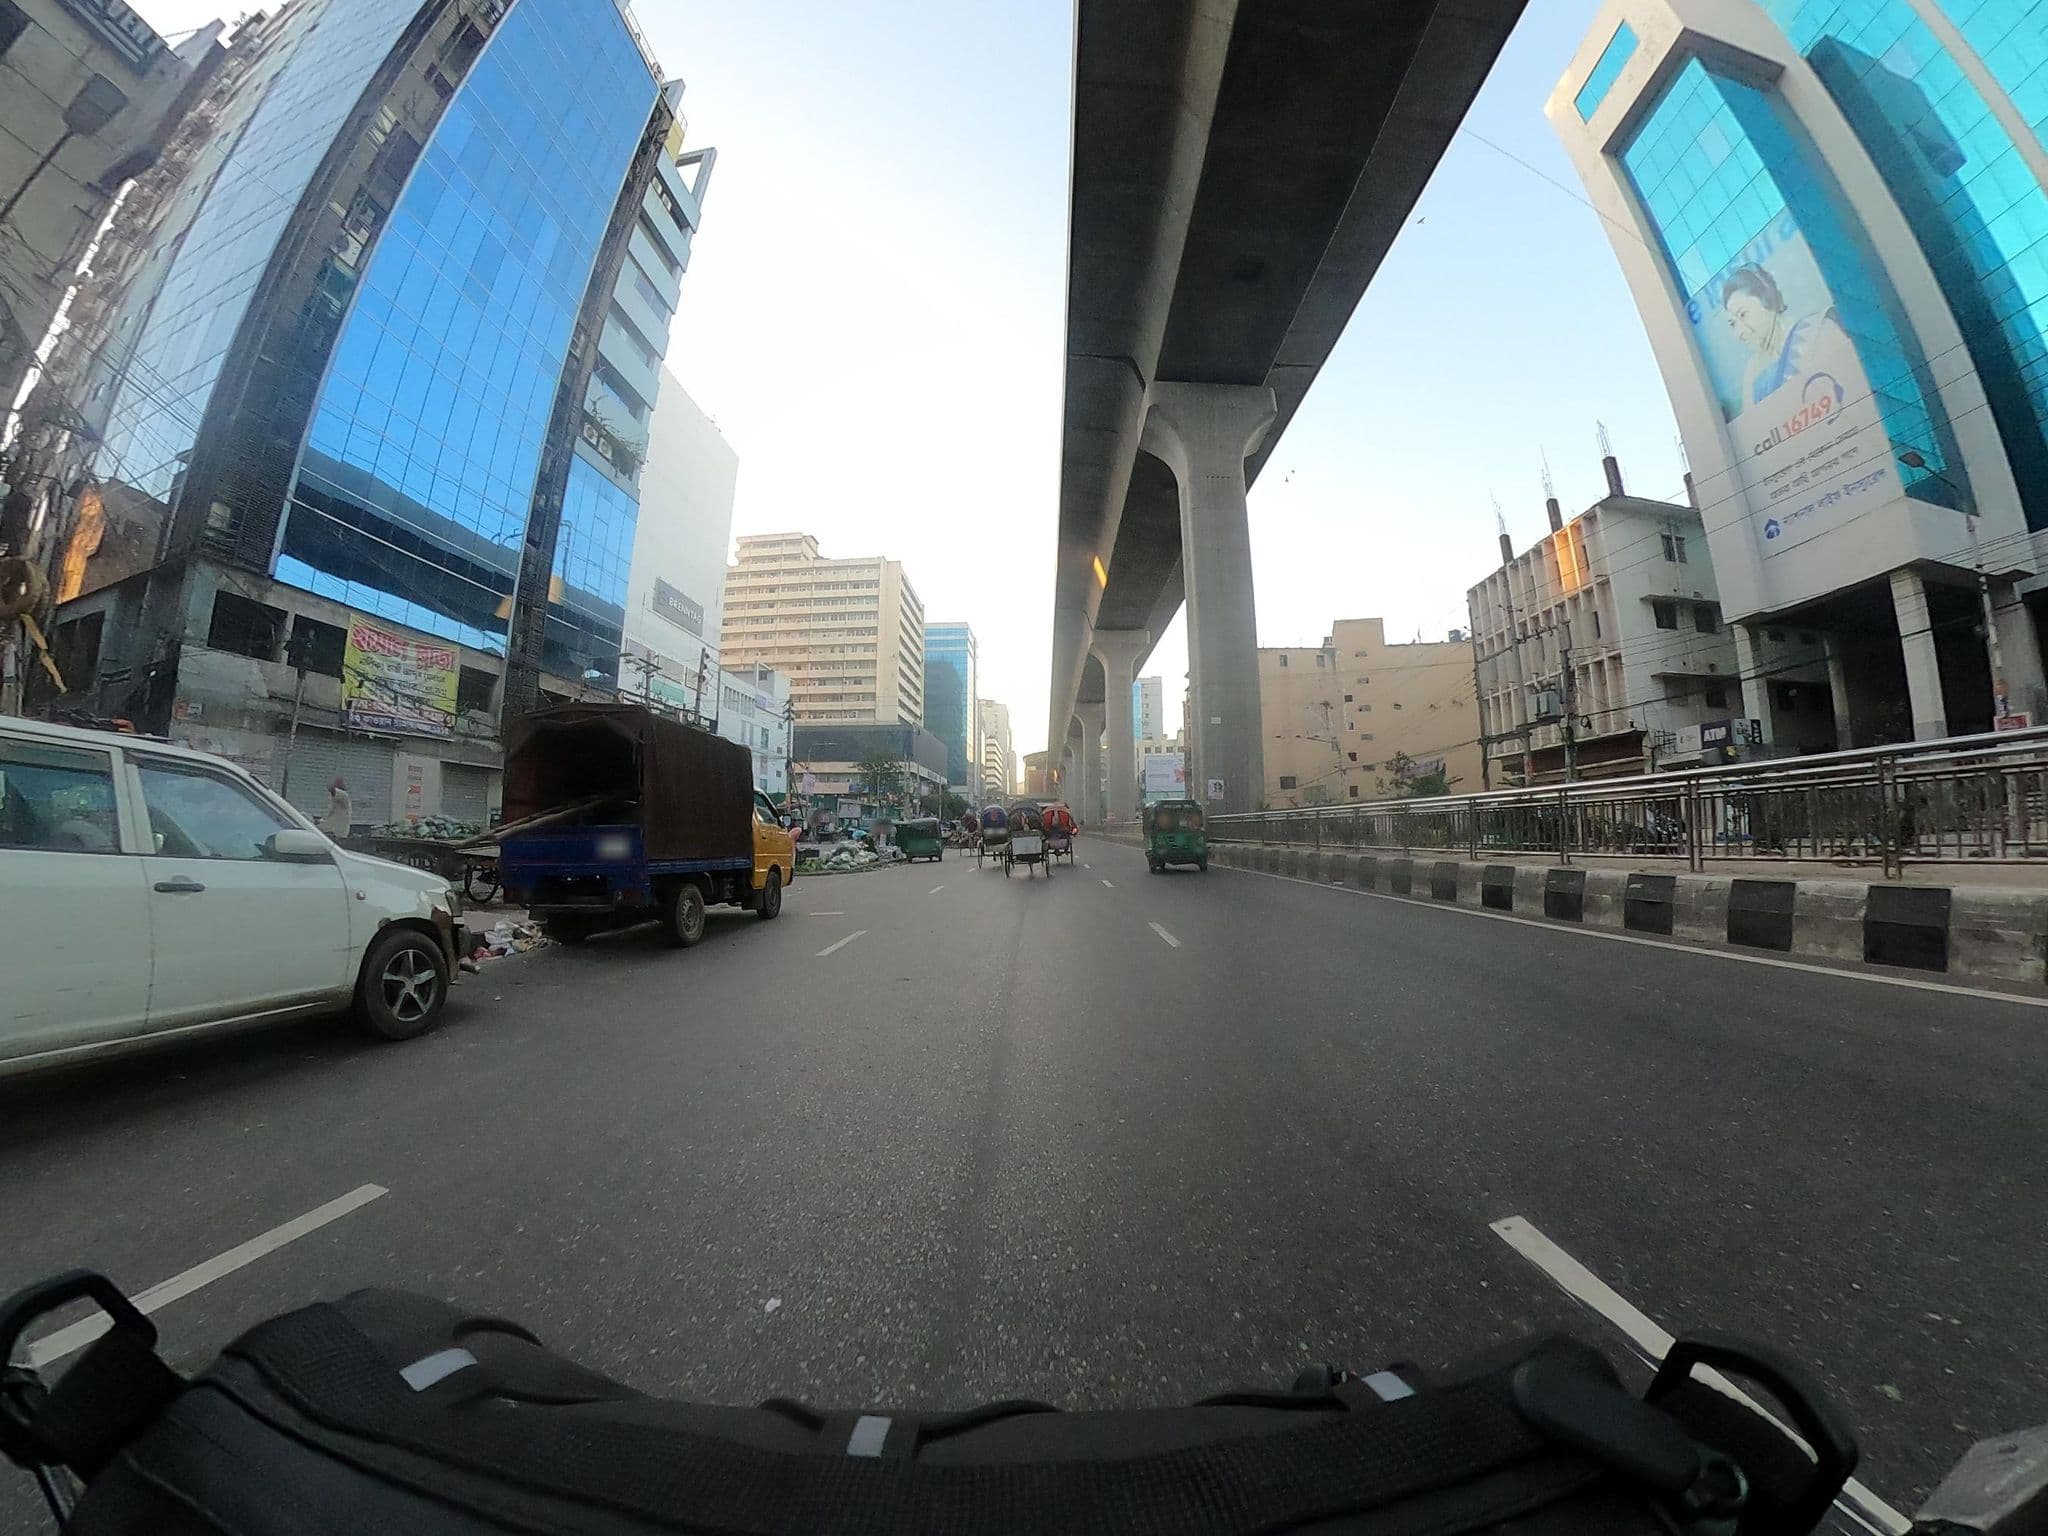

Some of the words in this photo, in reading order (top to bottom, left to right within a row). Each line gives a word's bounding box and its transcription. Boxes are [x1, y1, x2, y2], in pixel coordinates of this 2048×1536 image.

[1754, 427, 1781, 455] call
[1783, 395, 1832, 436] 16749
[1703, 726, 1727, 742] ATM
